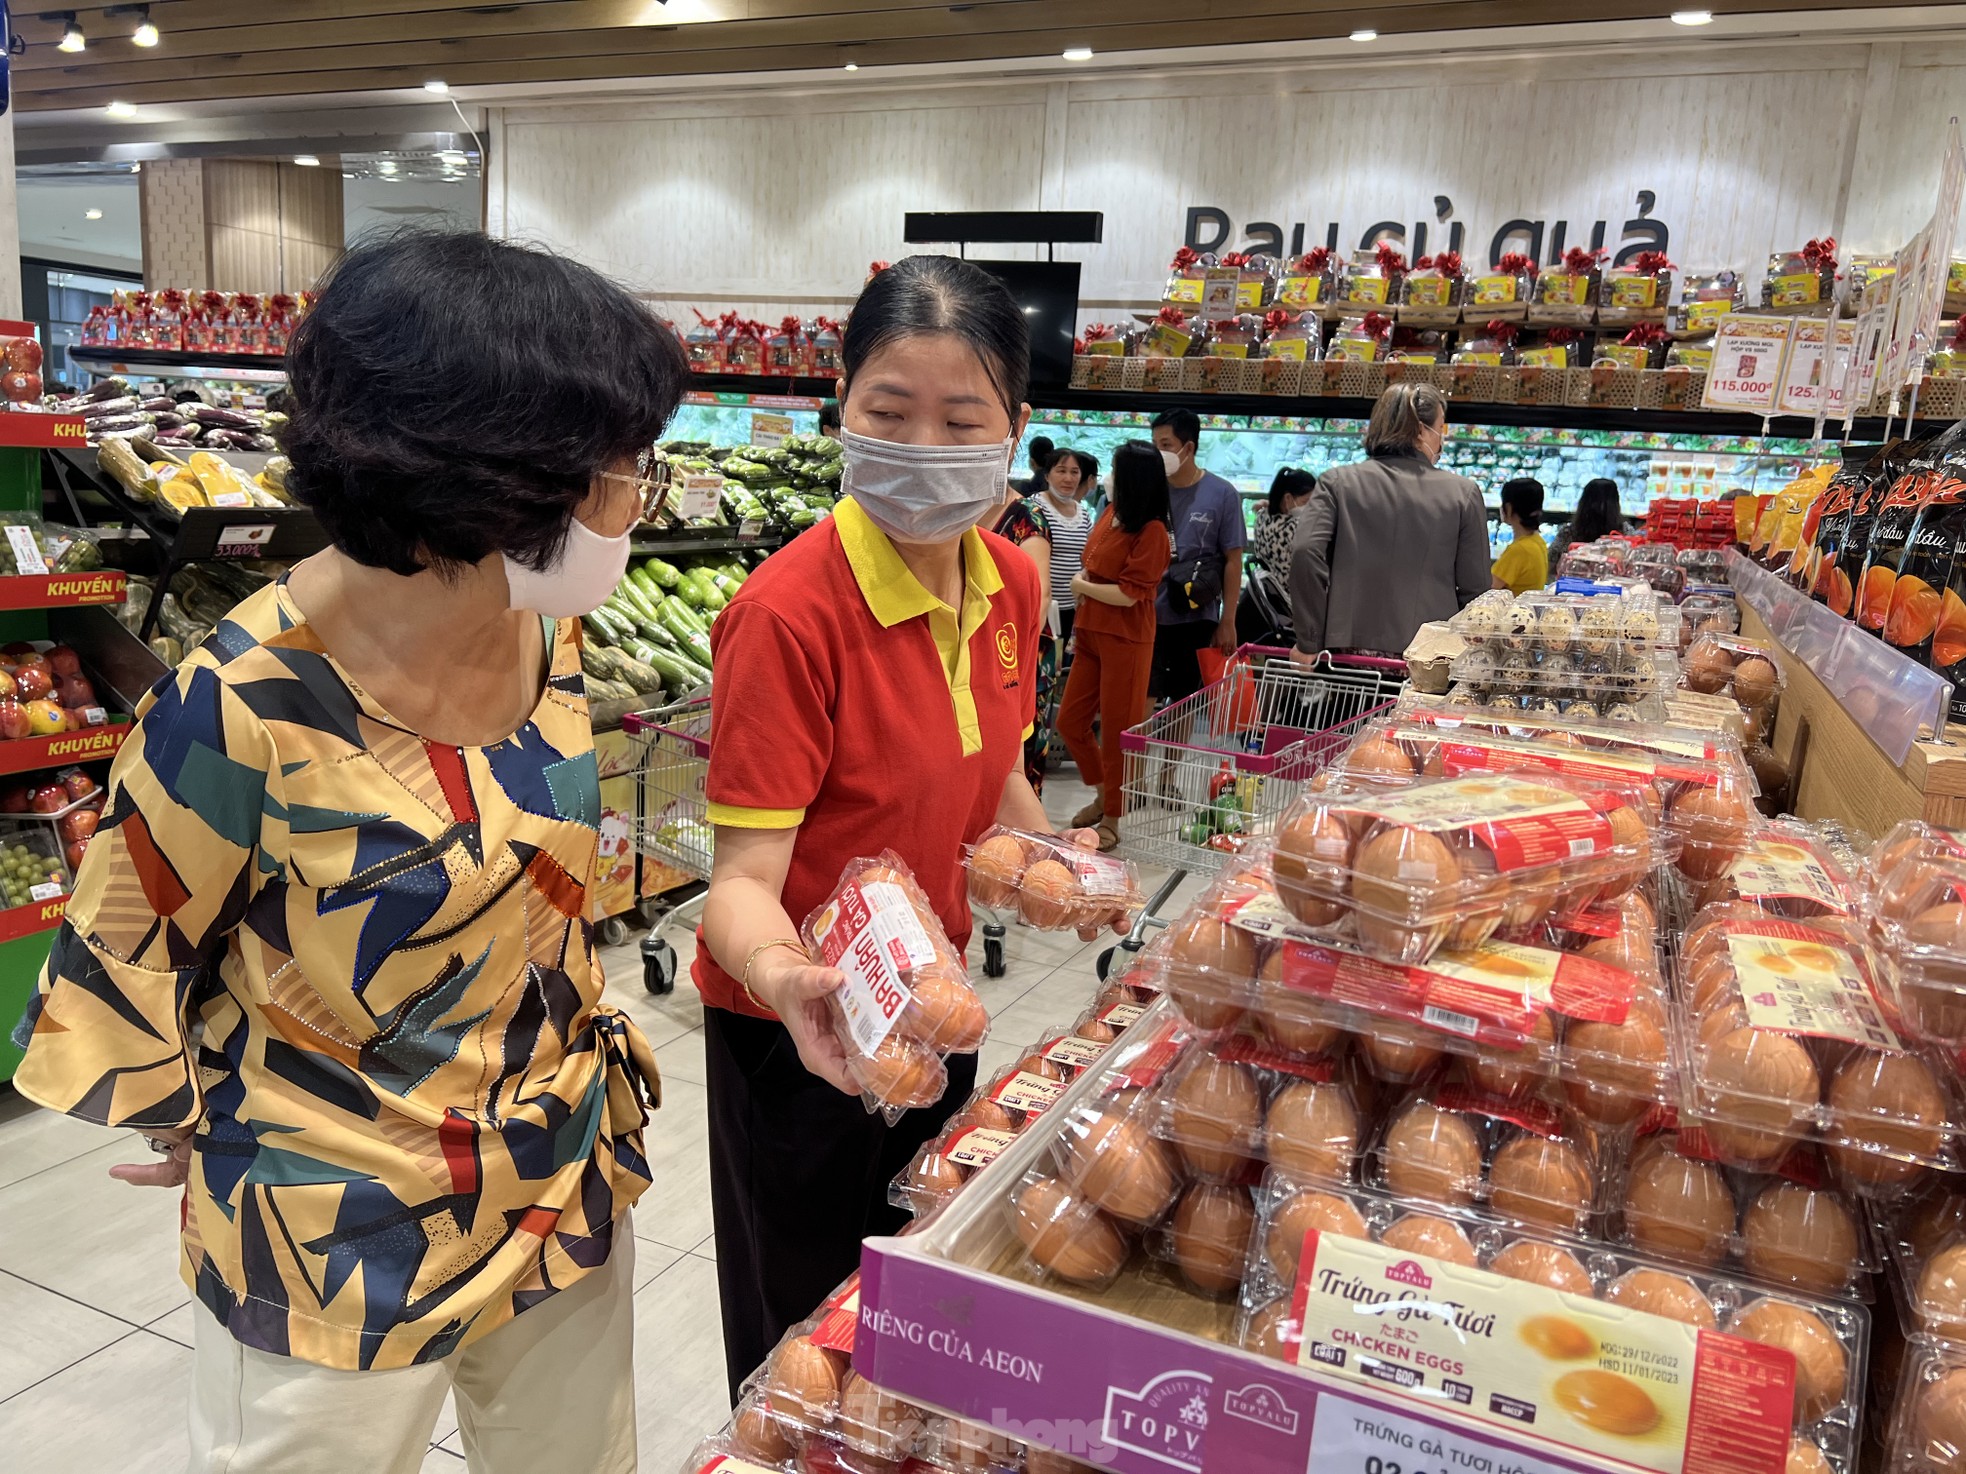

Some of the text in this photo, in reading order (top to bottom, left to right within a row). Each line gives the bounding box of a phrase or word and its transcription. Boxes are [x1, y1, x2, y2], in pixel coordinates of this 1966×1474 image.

[1184, 206, 1338, 257] Rau
[54, 423, 86, 437] KHU
[47, 575, 112, 596] KHUYẾN
[48, 731, 114, 756] KHUYẾN
[41, 901, 69, 920] KH
[854, 932, 887, 989] HUÂN
[874, 978, 903, 1019] BA
[1387, 1270, 1431, 1287] TOPVALU
[1318, 1268, 1496, 1338] Trứng Gà Tươi
[862, 1304, 1044, 1383] RIÊNG CỦA AEON
[1379, 1322, 1420, 1344] たまご
[1331, 1328, 1464, 1376] CHICKEN EGGS
[1622, 1361, 1679, 1385] 11/01/2023
[1149, 1382, 1190, 1408] QUALITY
[1231, 1399, 1291, 1426] TOPVALU
[1121, 1409, 1200, 1451] TOPV
[1353, 1417, 1492, 1473] TRỨNG GÀ TƯƠI
